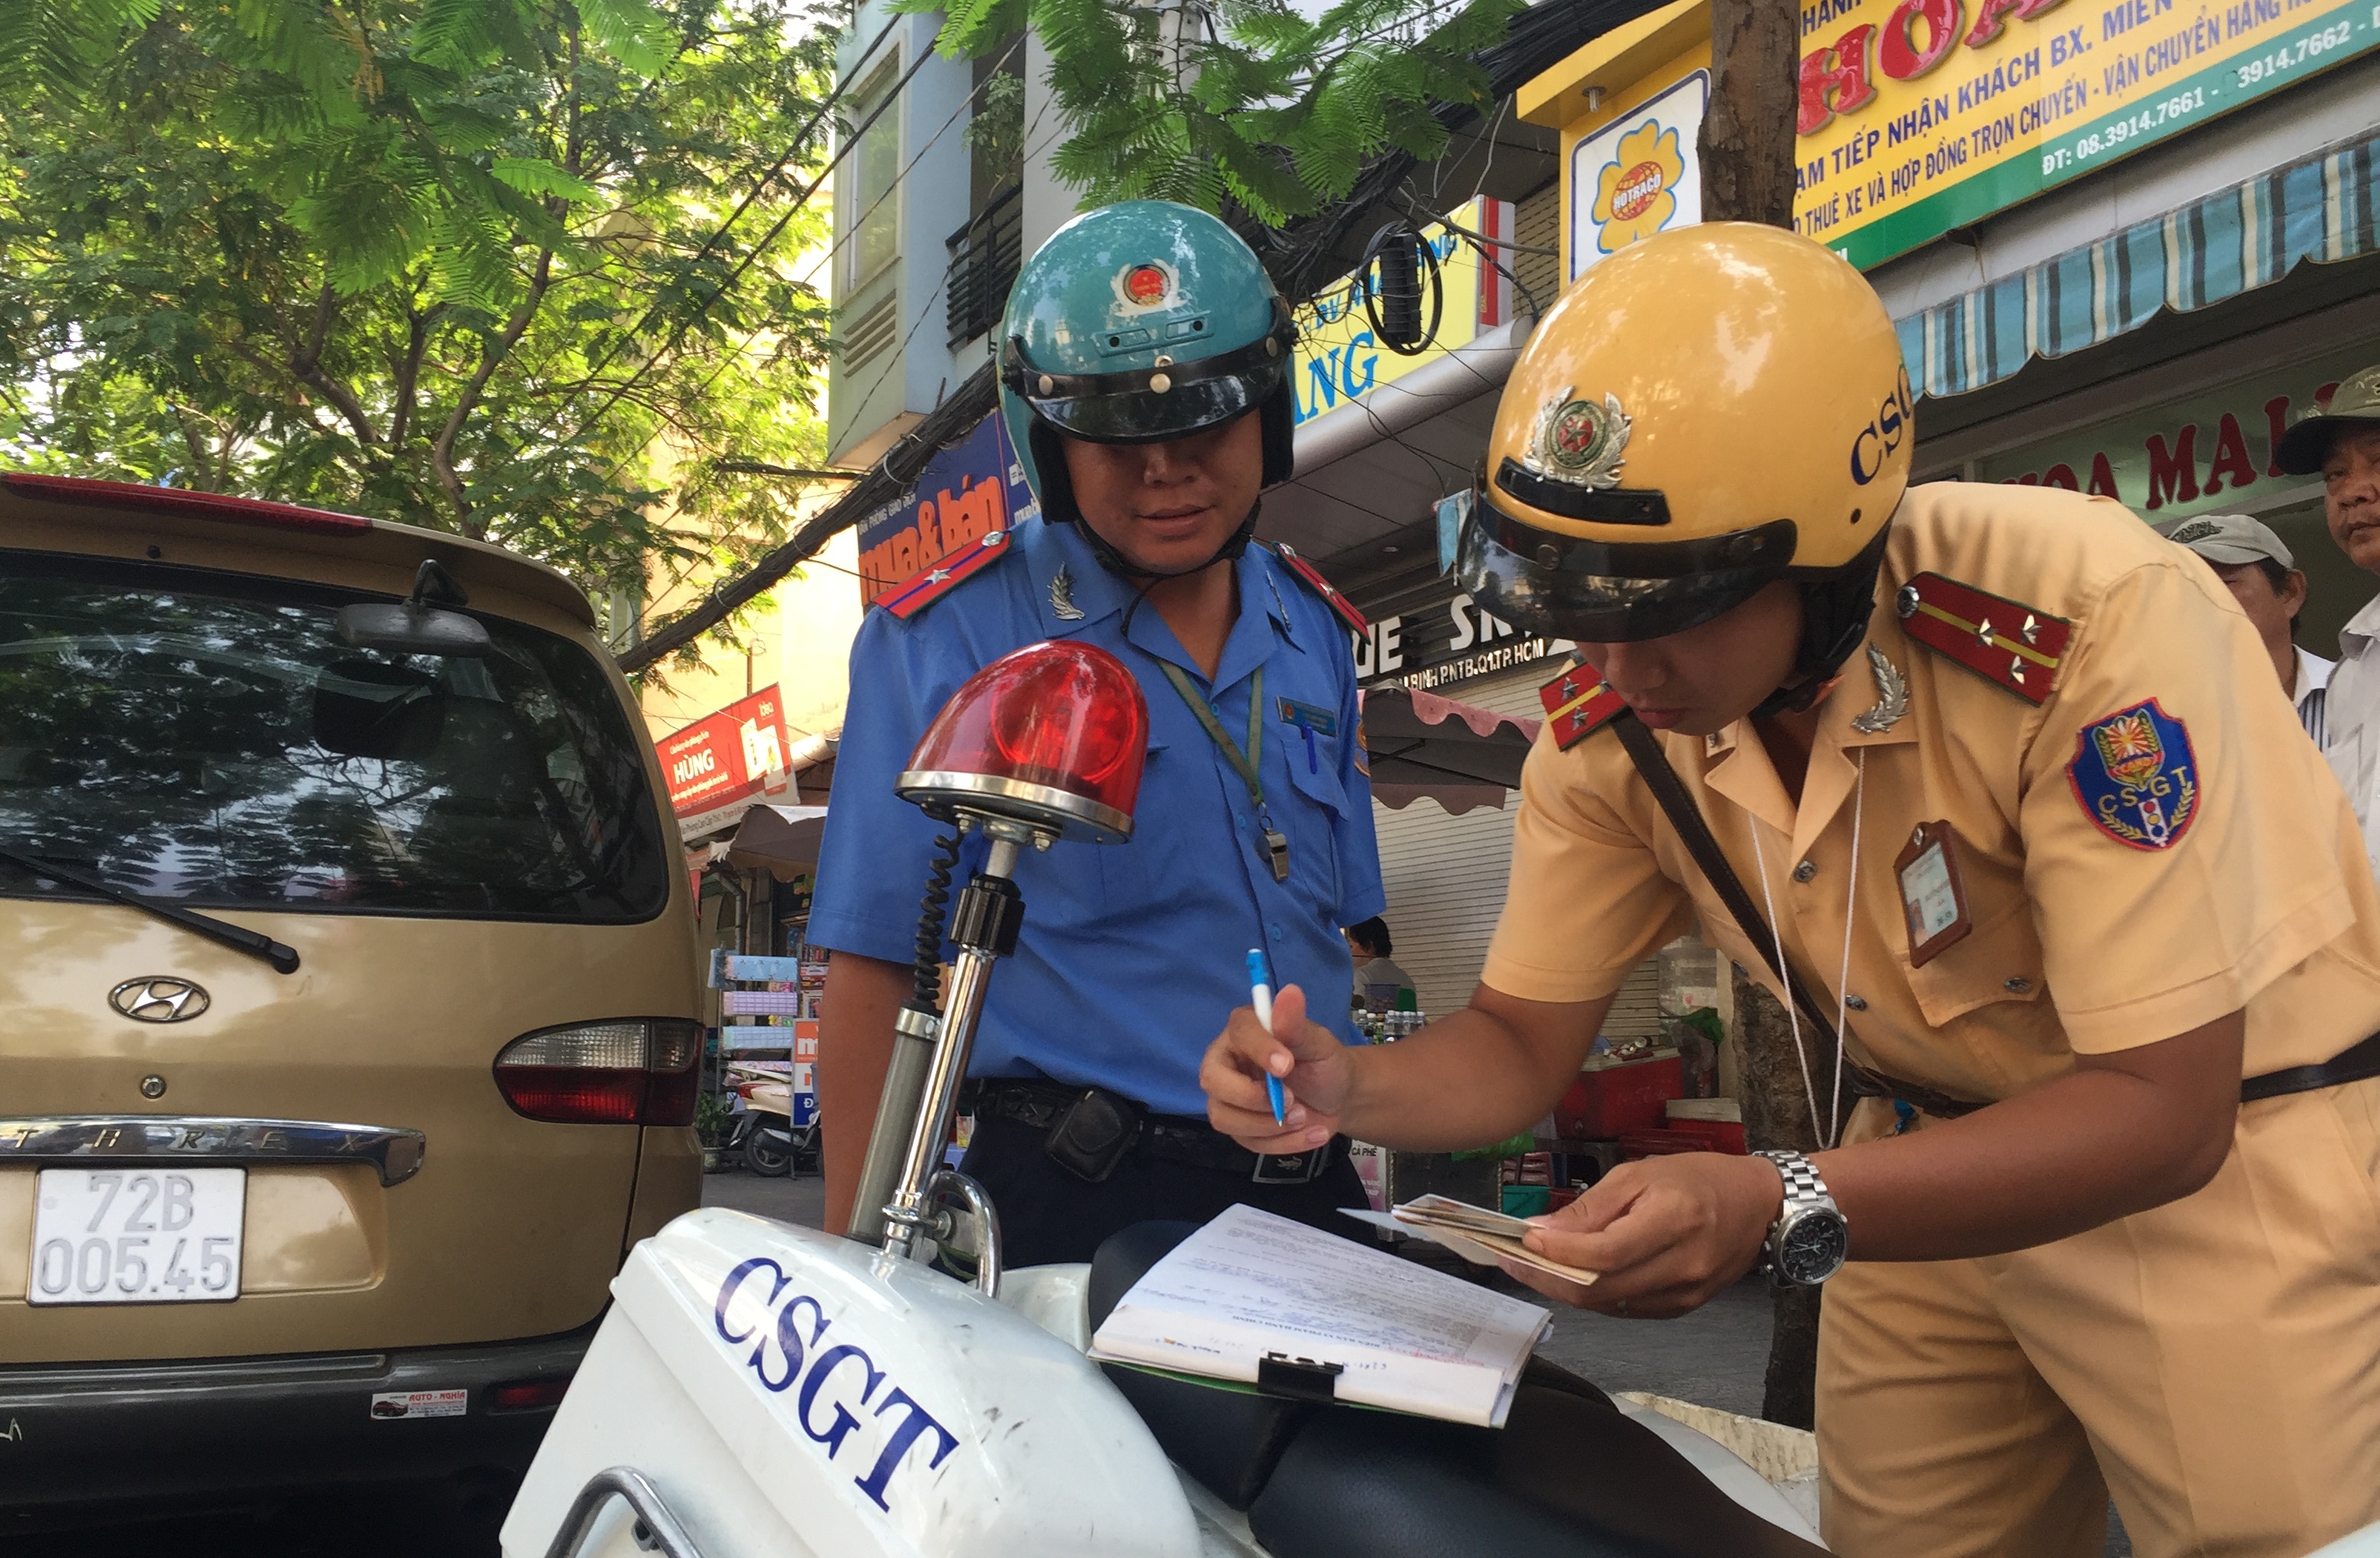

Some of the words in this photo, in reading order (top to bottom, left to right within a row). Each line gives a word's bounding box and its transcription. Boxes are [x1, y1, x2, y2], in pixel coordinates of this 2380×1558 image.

[1805, 192, 1840, 236] THUÊ
[1845, 186, 1863, 219] XE
[1867, 170, 1886, 207] VÀ
[1890, 157, 1920, 198] HỢP
[1926, 136, 1967, 181] ĐỒNG
[1971, 113, 2015, 157] TRỌN
[2019, 72, 2087, 136] CHUYẾN
[2104, 53, 2139, 99] VẬN
[2145, 5, 2220, 78] CHUYỂN
[1831, 124, 1880, 175] TIẾP
[1887, 94, 1949, 148] NHẬN
[1958, 47, 2040, 114] KHÁCH
[2050, 25, 2092, 68] BX.
[2042, 148, 2072, 176] ĐT:
[2076, 86, 2205, 160] 08.3914.7661
[2237, 20, 2351, 89] 3914.7662
[1614, 173, 1661, 210] HOTRACO
[673, 748, 715, 785] HÙNG
[2098, 765, 2188, 815] CSGT
[86, 1175, 195, 1233] 72B
[38, 1236, 235, 1295] 005.45
[714, 1257, 961, 1514] CSGT
